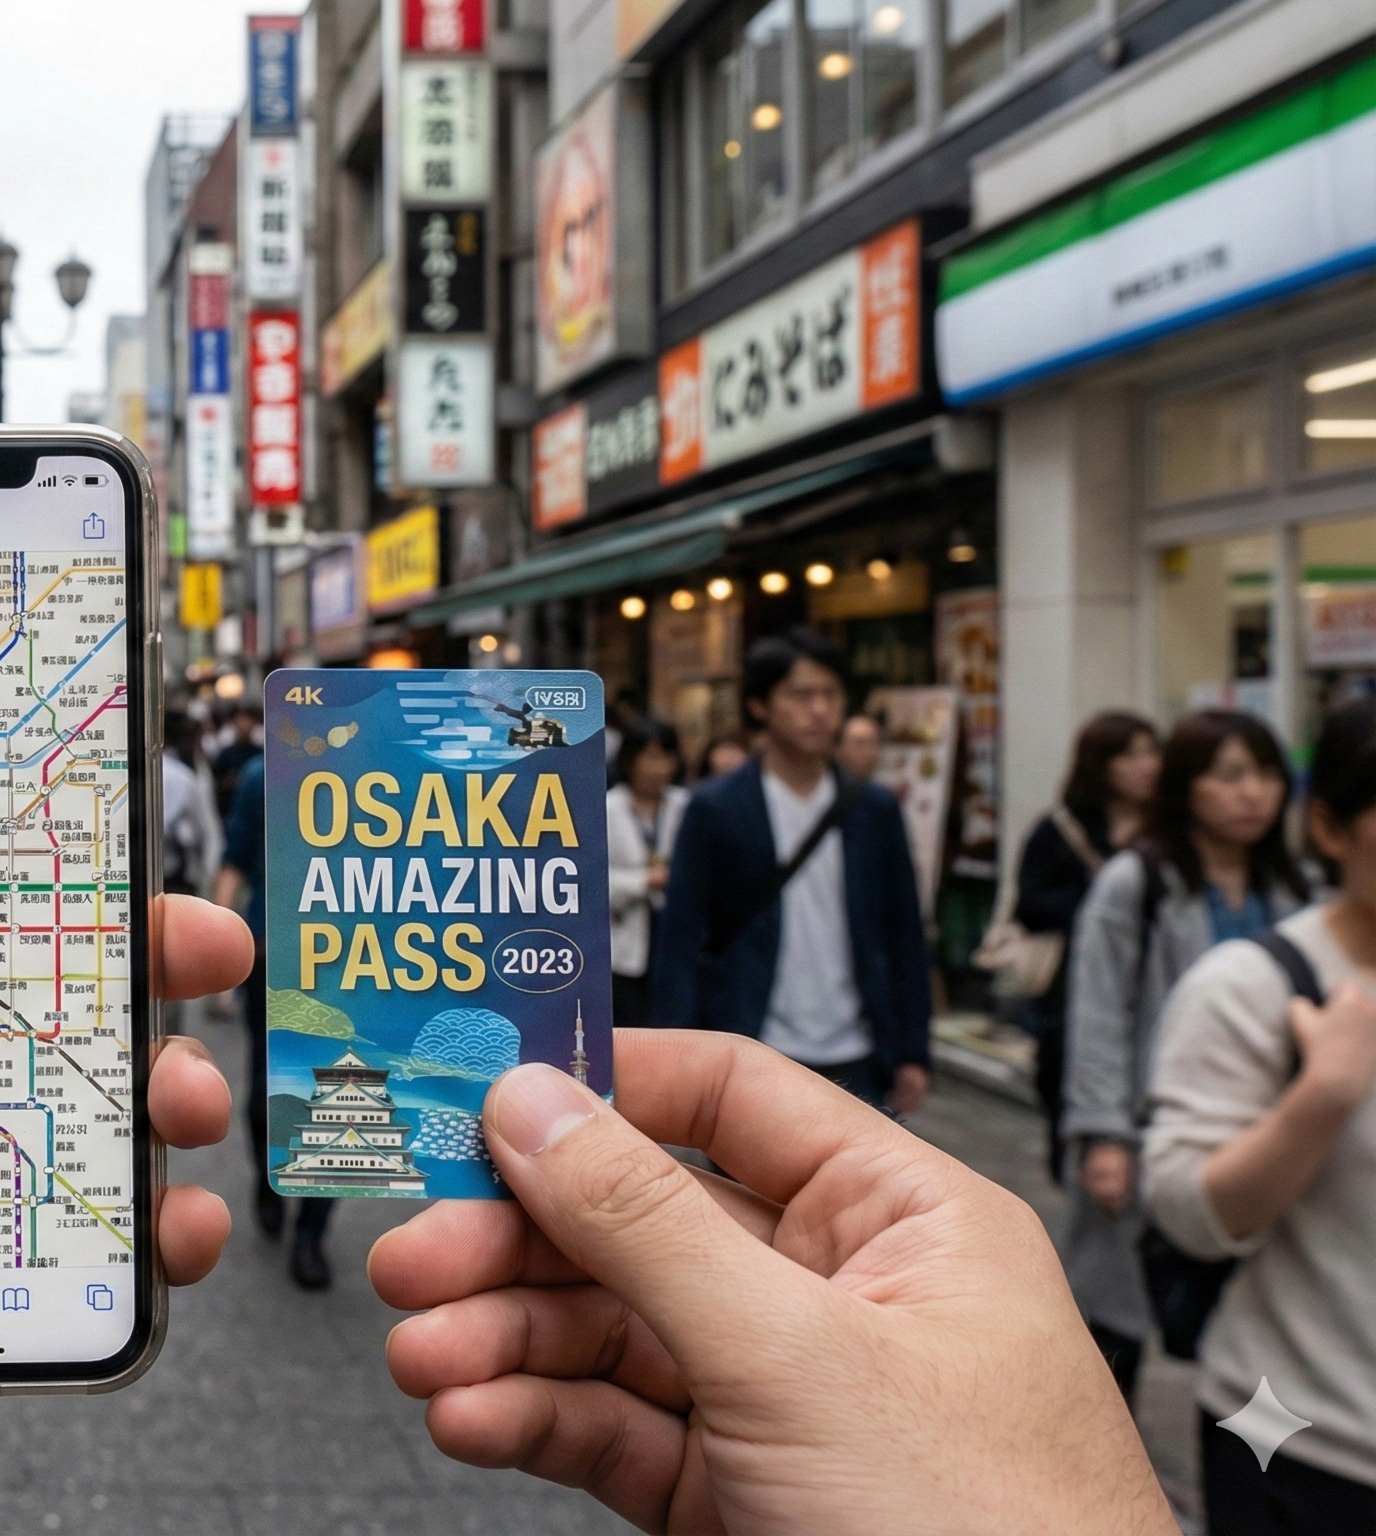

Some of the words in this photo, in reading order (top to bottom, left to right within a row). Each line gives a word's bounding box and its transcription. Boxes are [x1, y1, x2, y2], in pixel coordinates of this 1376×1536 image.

[284, 686, 324, 706] 4K
[298, 771, 580, 849] OSAKA
[297, 857, 580, 915] AMAZING
[299, 922, 487, 992] PASS
[501, 947, 575, 975] 2023
